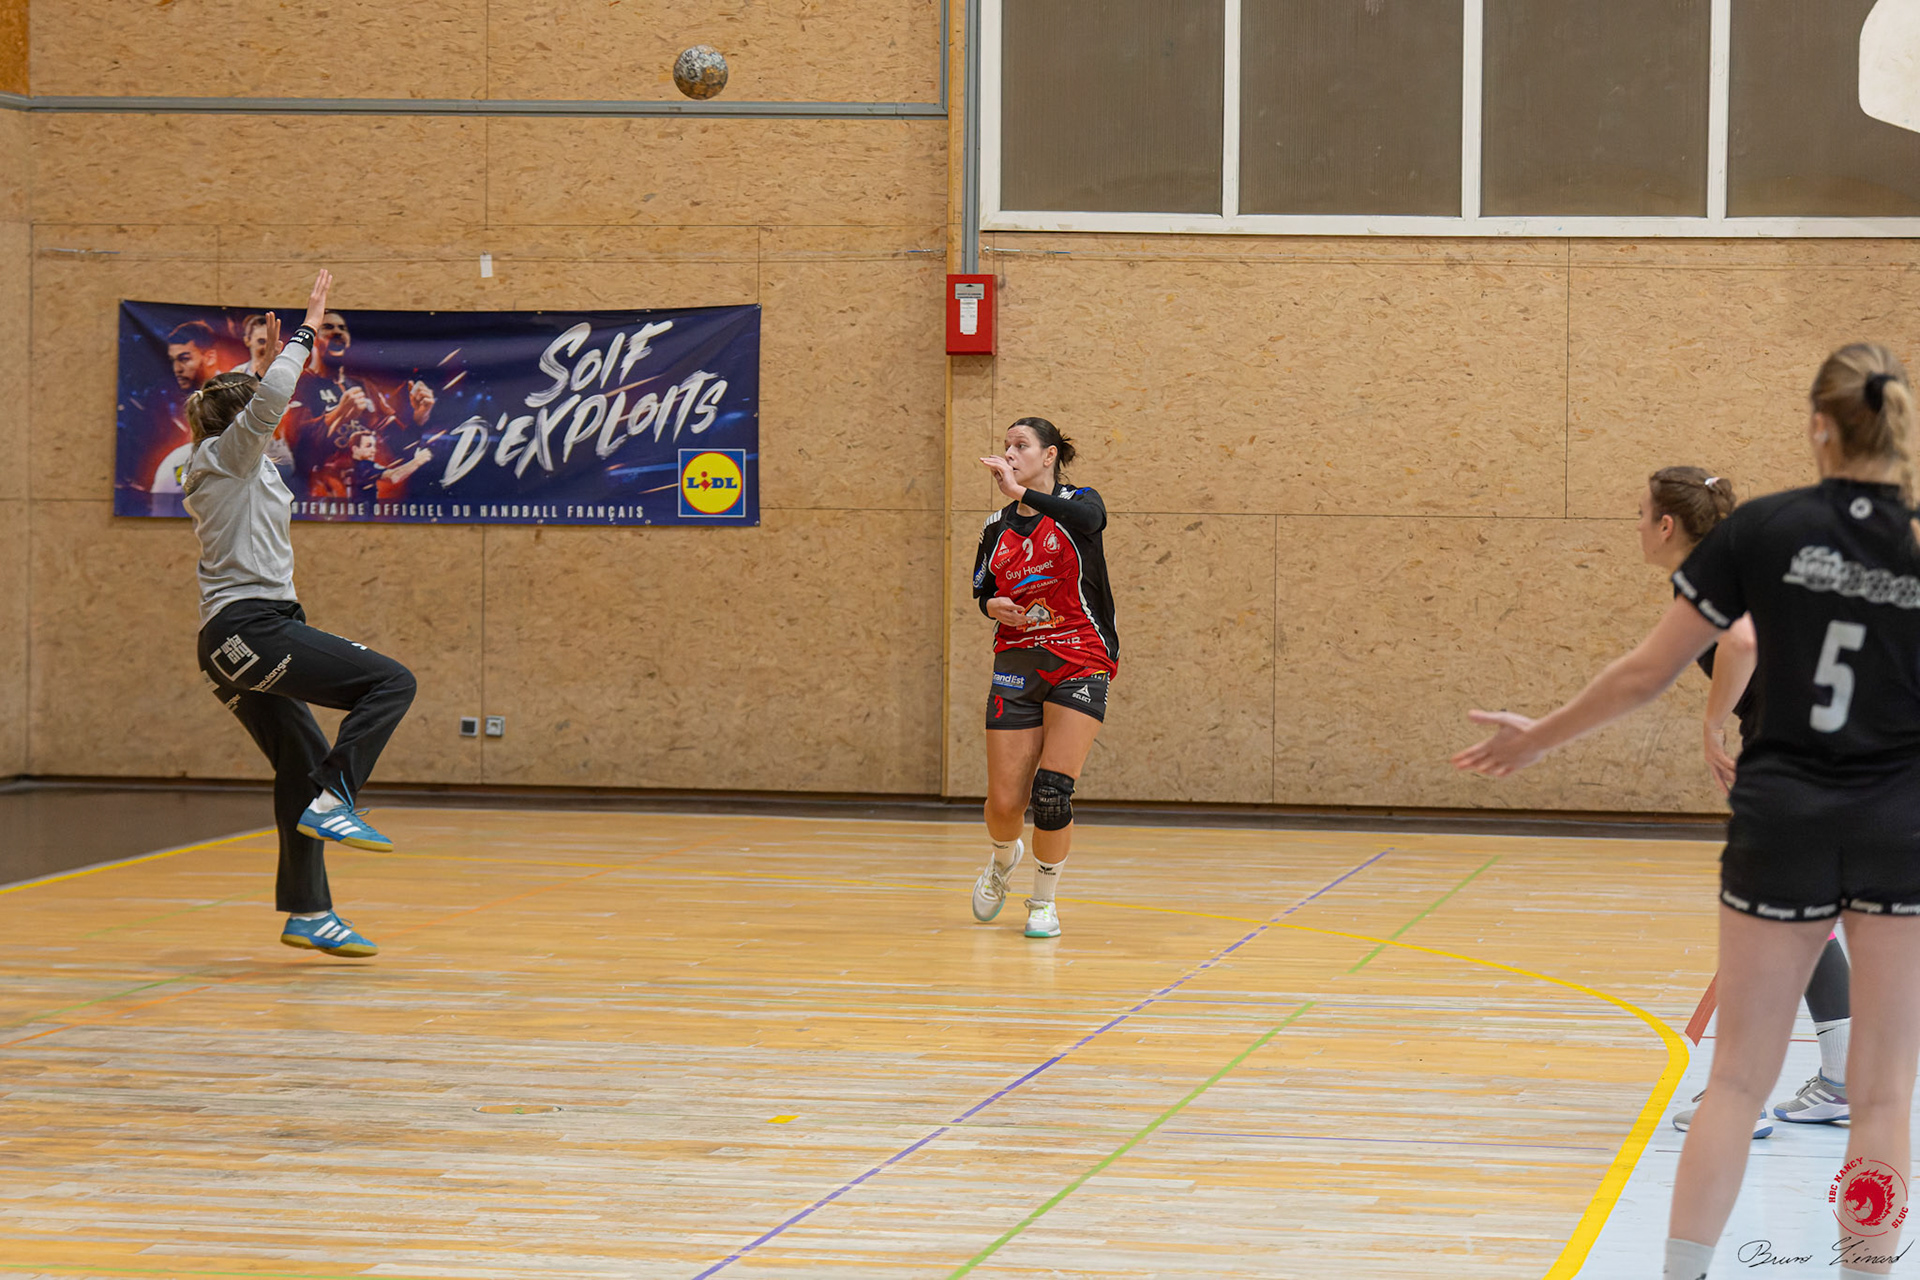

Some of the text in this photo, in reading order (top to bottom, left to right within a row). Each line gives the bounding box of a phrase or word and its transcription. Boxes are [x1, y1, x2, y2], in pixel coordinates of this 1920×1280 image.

[291, 501, 644, 522] RTENAIRE OFFICIEL DU HANDBALL FRANÇAIS
[1005, 570, 1022, 581] Guy
[1022, 560, 1054, 576] Hoquet
[1809, 620, 1867, 733] 5
[1072, 692, 1091, 704] SELECT
